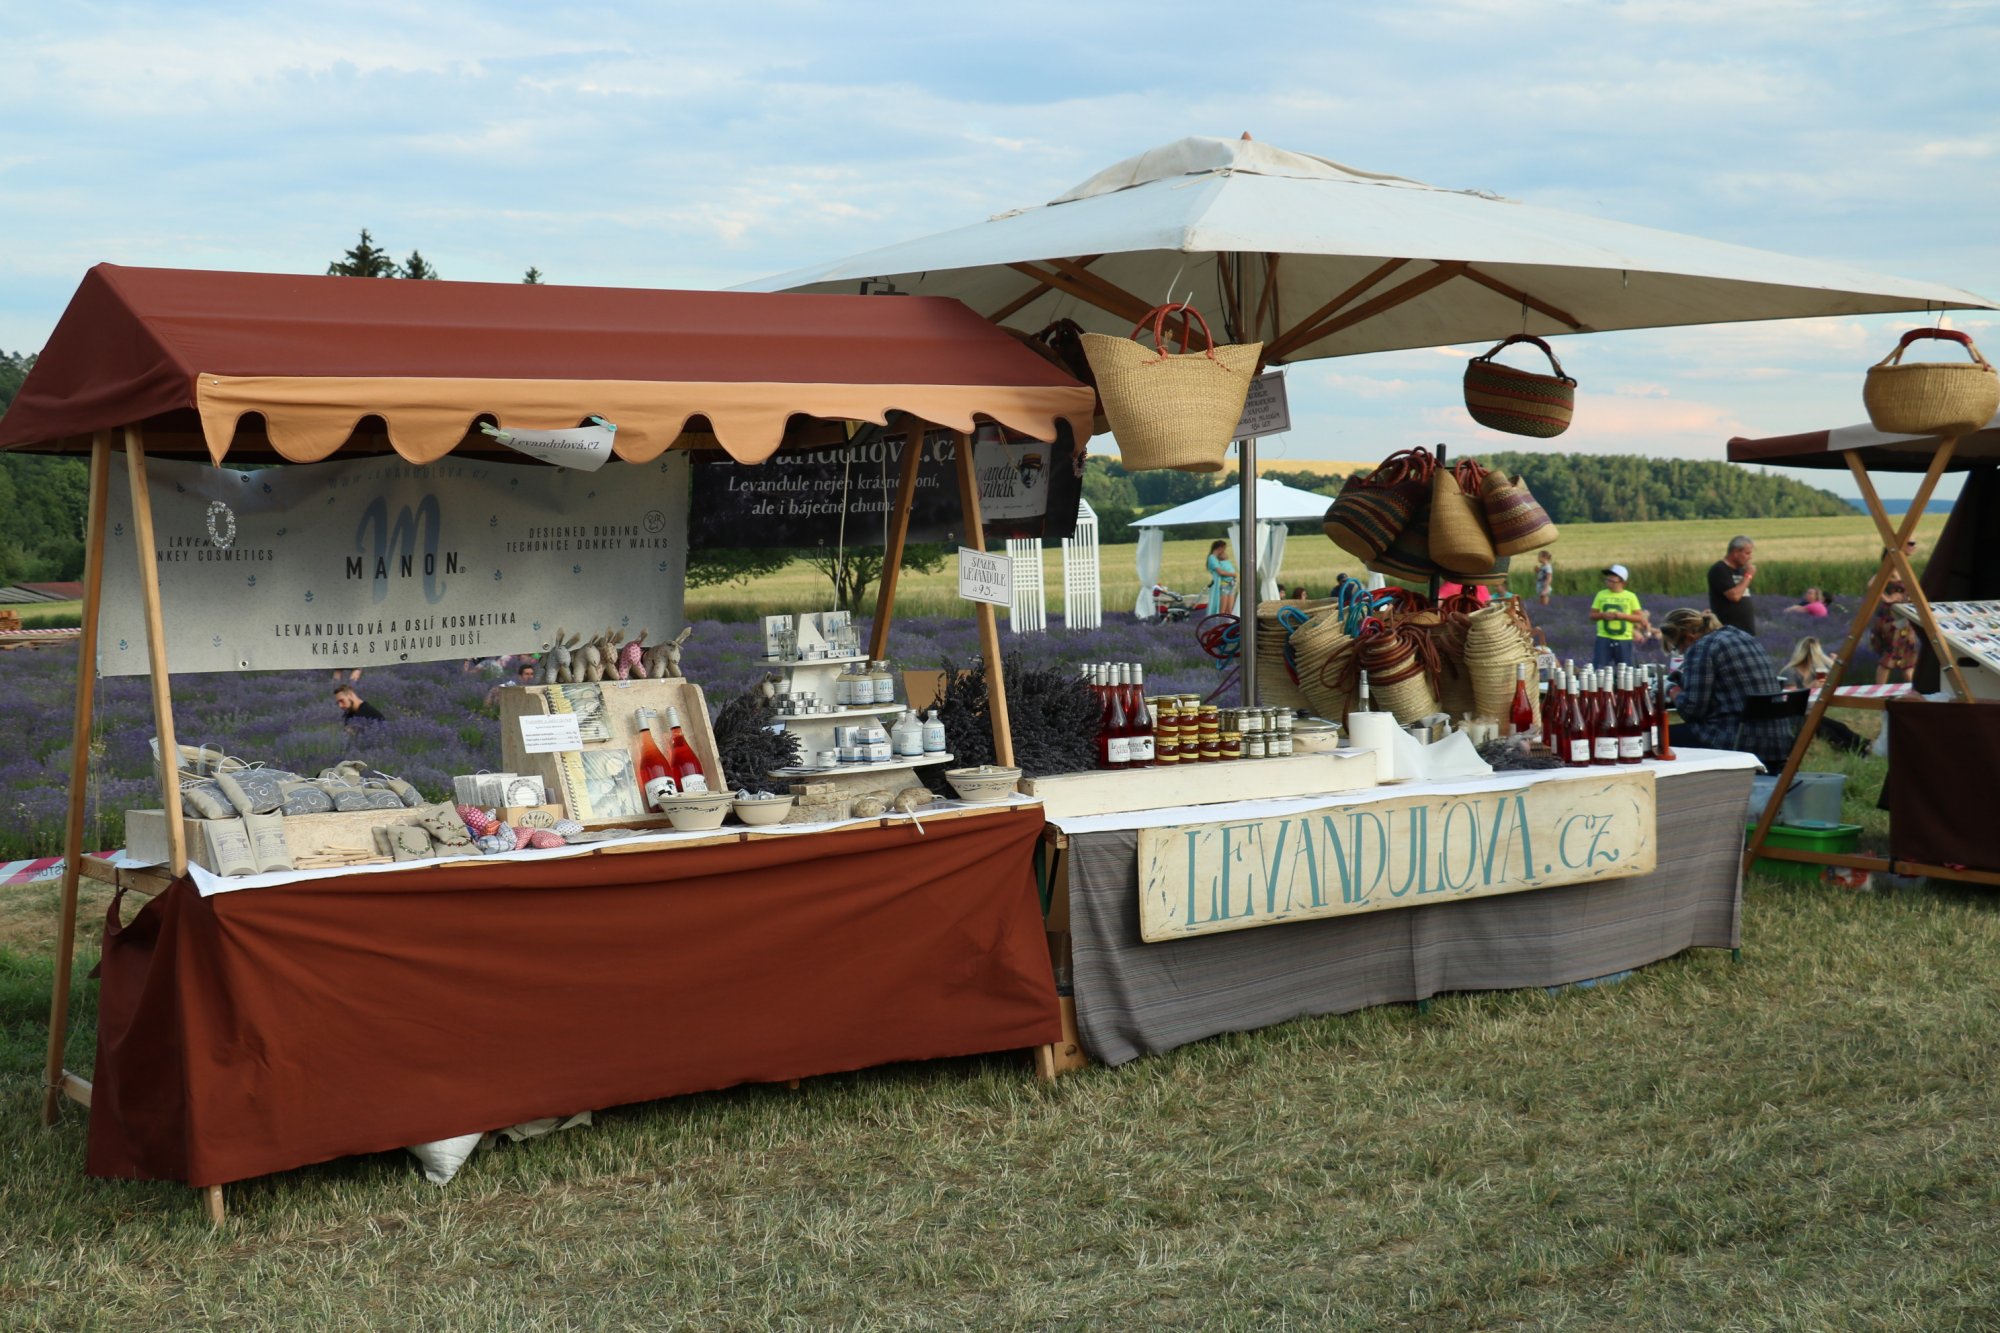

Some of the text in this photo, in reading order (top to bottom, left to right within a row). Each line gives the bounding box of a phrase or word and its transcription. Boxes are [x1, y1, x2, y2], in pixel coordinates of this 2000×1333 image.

[508, 436, 600, 450] Levandulová.cz
[728, 475, 810, 492] Levandule
[814, 475, 853, 495] nejen
[915, 473, 940, 489] oní,
[752, 499, 775, 515] ale
[779, 500, 785, 515] i
[789, 498, 845, 519] báječně
[169, 536, 236, 548] LAVEN
[529, 525, 639, 539] DESIGNED DURING
[577, 538, 622, 550] DONKEY
[629, 537, 669, 549] WALKS
[158, 549, 274, 562] NKEY COSMETICS
[963, 566, 1006, 587] LEVANDULE
[275, 611, 518, 637] LEVANDULOVÁ A OSLÍ KOSMETIKA
[312, 640, 359, 655] KRÁSA
[369, 641, 376, 654] S
[385, 635, 442, 652] VOŇAVOU
[1184, 789, 1619, 927] LEVANDULOVÁ.CZ
